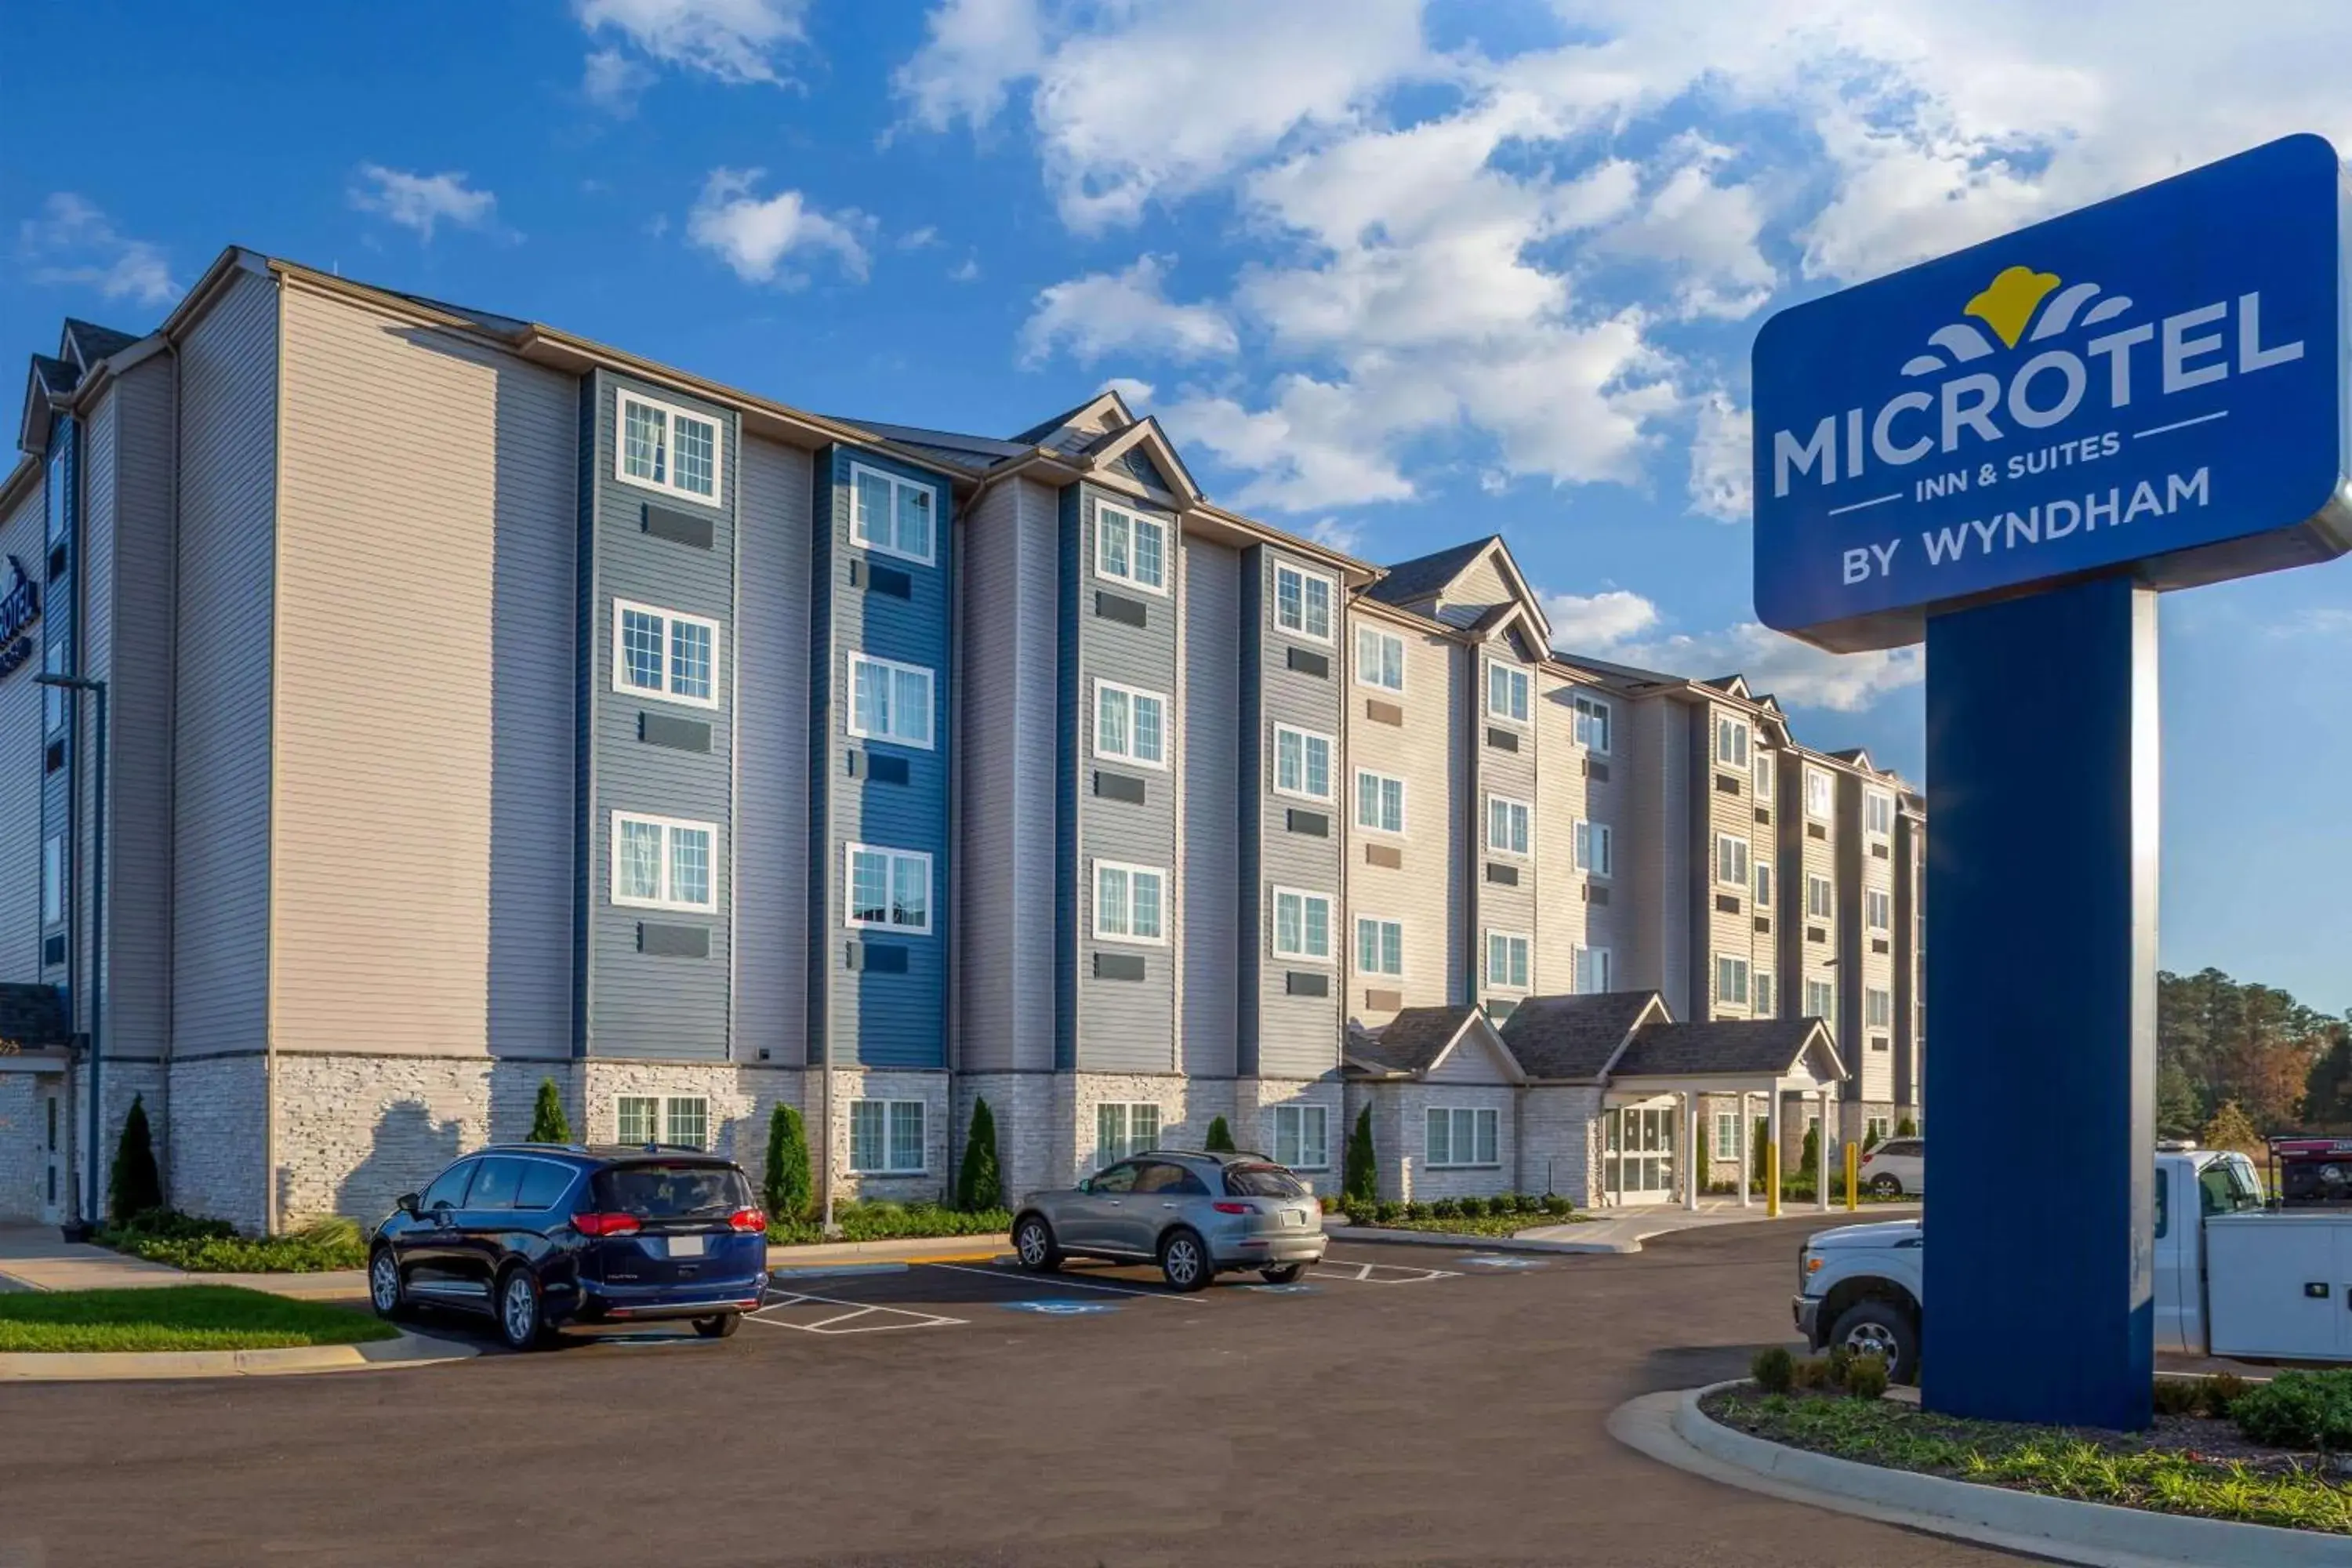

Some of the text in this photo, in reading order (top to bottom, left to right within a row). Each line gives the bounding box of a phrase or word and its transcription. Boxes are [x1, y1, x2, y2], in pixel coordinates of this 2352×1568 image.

[1773, 291, 2303, 498] MICROTEL
[1843, 466, 2209, 586] BY WYNDHAM
[1916, 432, 2121, 503] INN & SUITES
